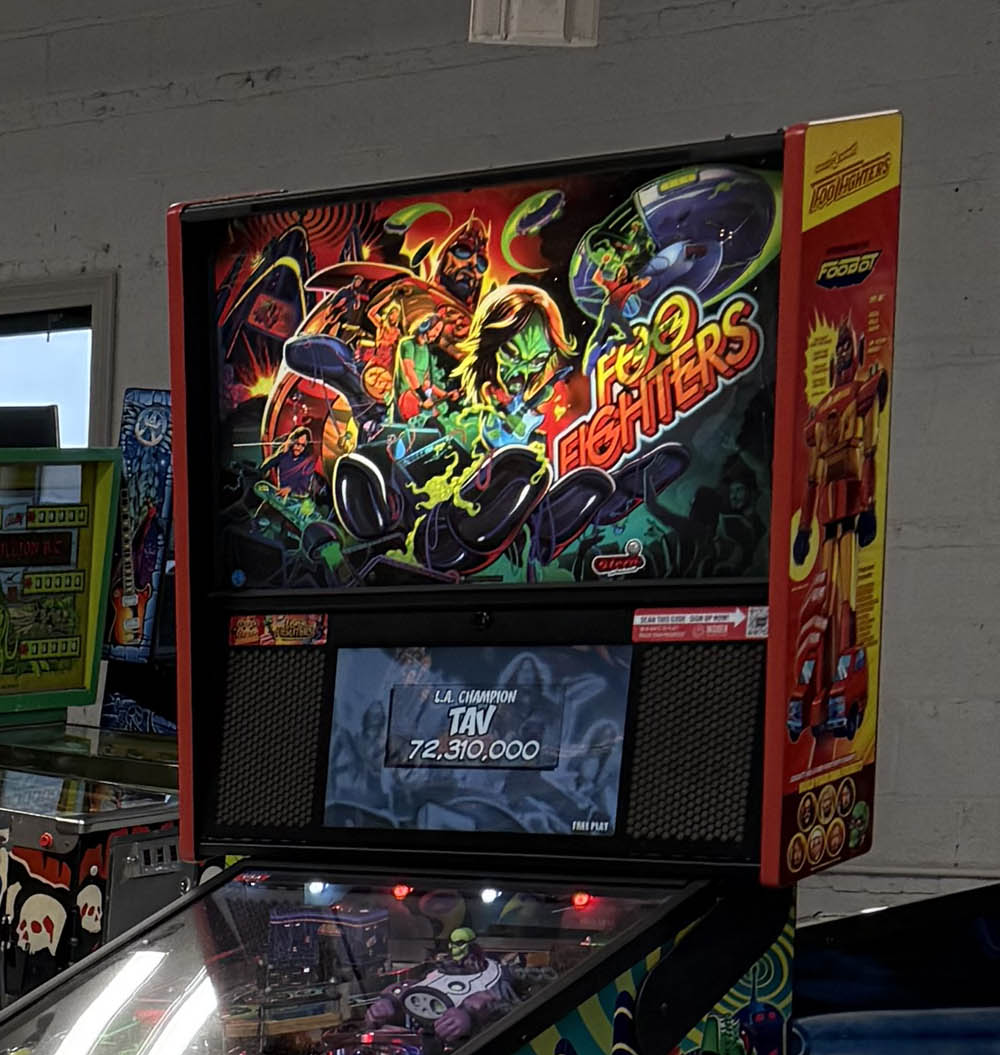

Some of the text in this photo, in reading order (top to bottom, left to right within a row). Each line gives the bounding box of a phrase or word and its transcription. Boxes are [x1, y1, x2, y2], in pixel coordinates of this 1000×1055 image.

[597, 294, 699, 405] FOO
[559, 299, 760, 477] FIGHTERS
[434, 689, 517, 704] L.A. CHAMPION
[449, 705, 497, 736] TAV
[408, 739, 540, 761] 72,310,000
[590, 822, 609, 831] PLAY
